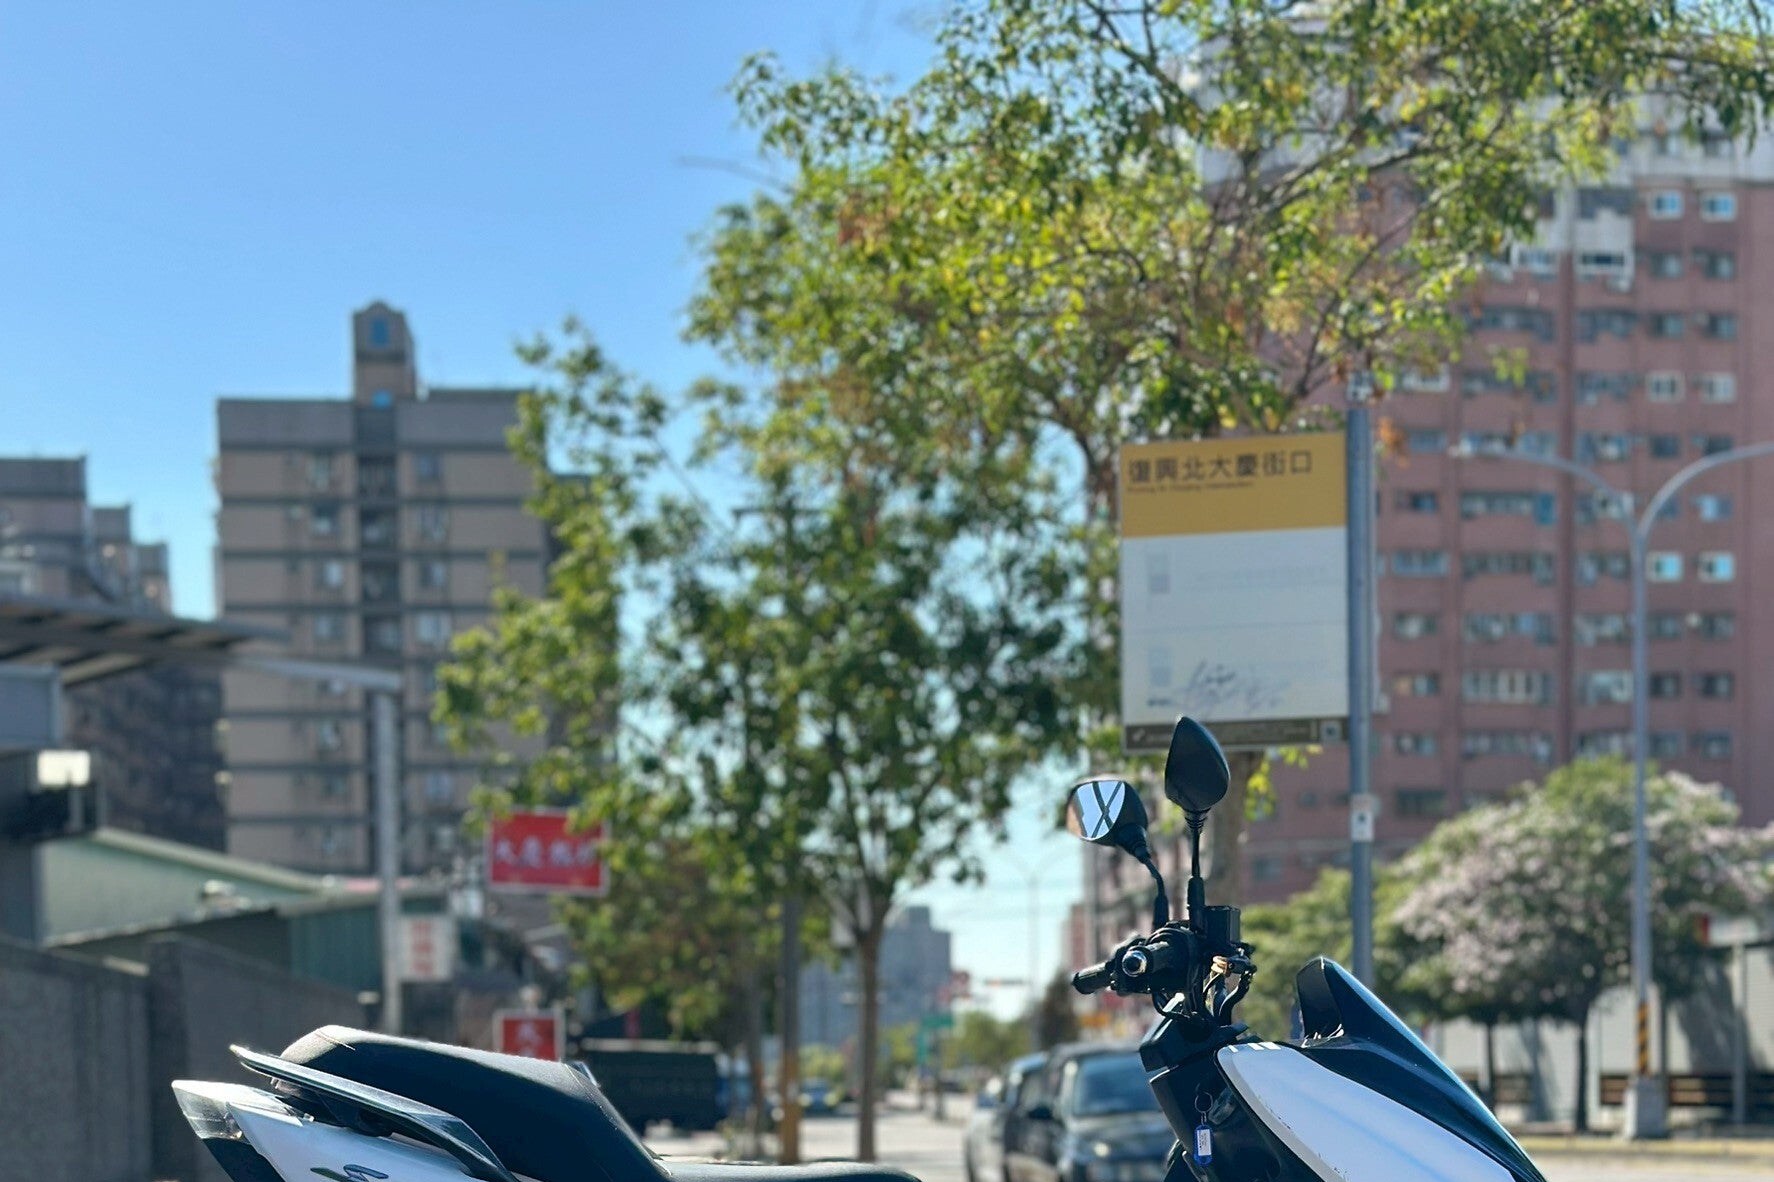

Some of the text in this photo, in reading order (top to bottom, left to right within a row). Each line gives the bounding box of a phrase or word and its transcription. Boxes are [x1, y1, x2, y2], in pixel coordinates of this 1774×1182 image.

[1128, 451, 1312, 482] 復興北大慶街口
